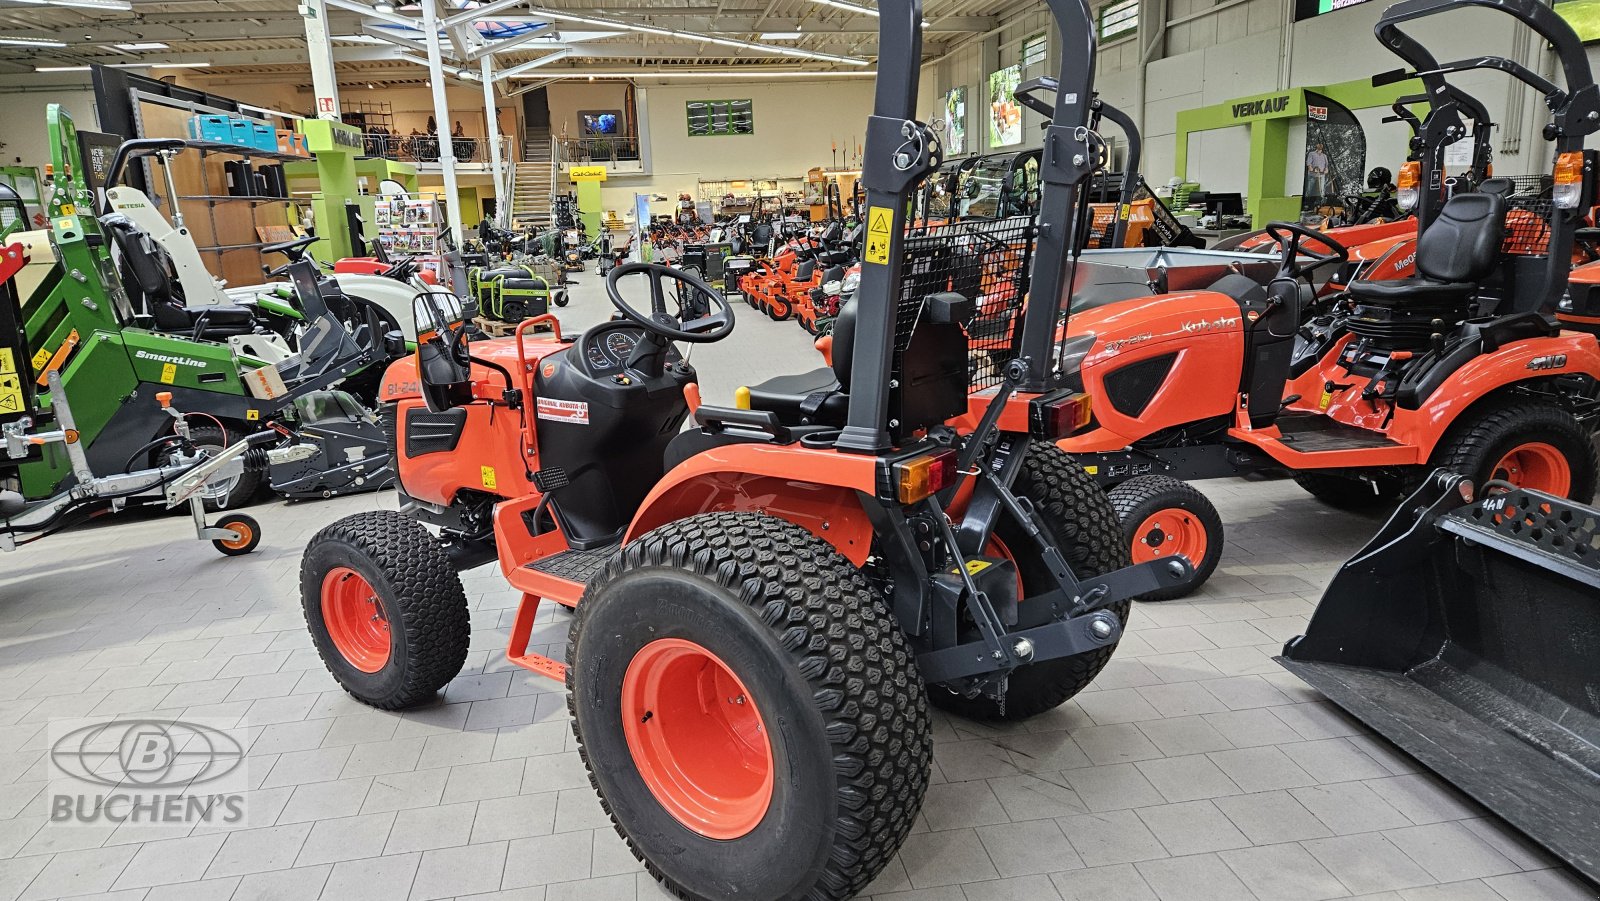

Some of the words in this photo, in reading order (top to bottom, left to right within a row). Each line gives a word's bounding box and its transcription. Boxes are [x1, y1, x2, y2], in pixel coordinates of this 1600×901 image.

[1232, 96, 1290, 118] VERKAUF
[93, 164, 103, 172] FOR
[1180, 316, 1237, 334] Kubota
[135, 350, 207, 368] SmartLine
